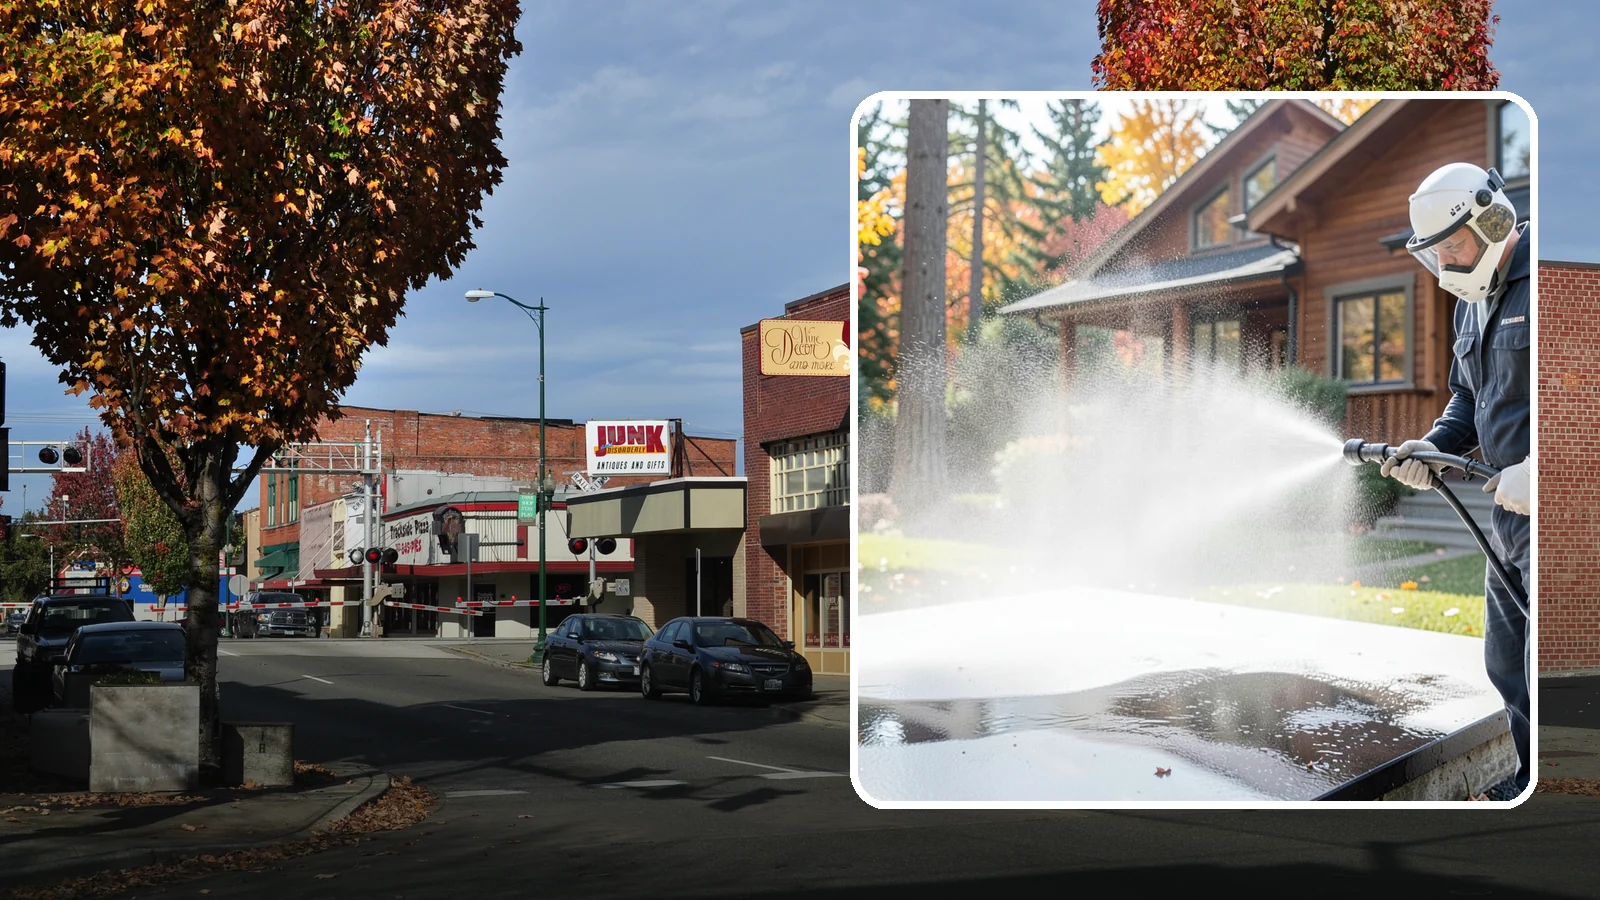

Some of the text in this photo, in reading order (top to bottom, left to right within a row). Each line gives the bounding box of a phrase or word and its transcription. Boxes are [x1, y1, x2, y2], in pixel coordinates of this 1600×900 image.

[595, 425, 665, 457] JUNK
[607, 446, 645, 454] DISORDERLY
[597, 460, 665, 470] ANTIQUES AND GIFTS
[390, 519, 429, 539] Trackside Pizza
